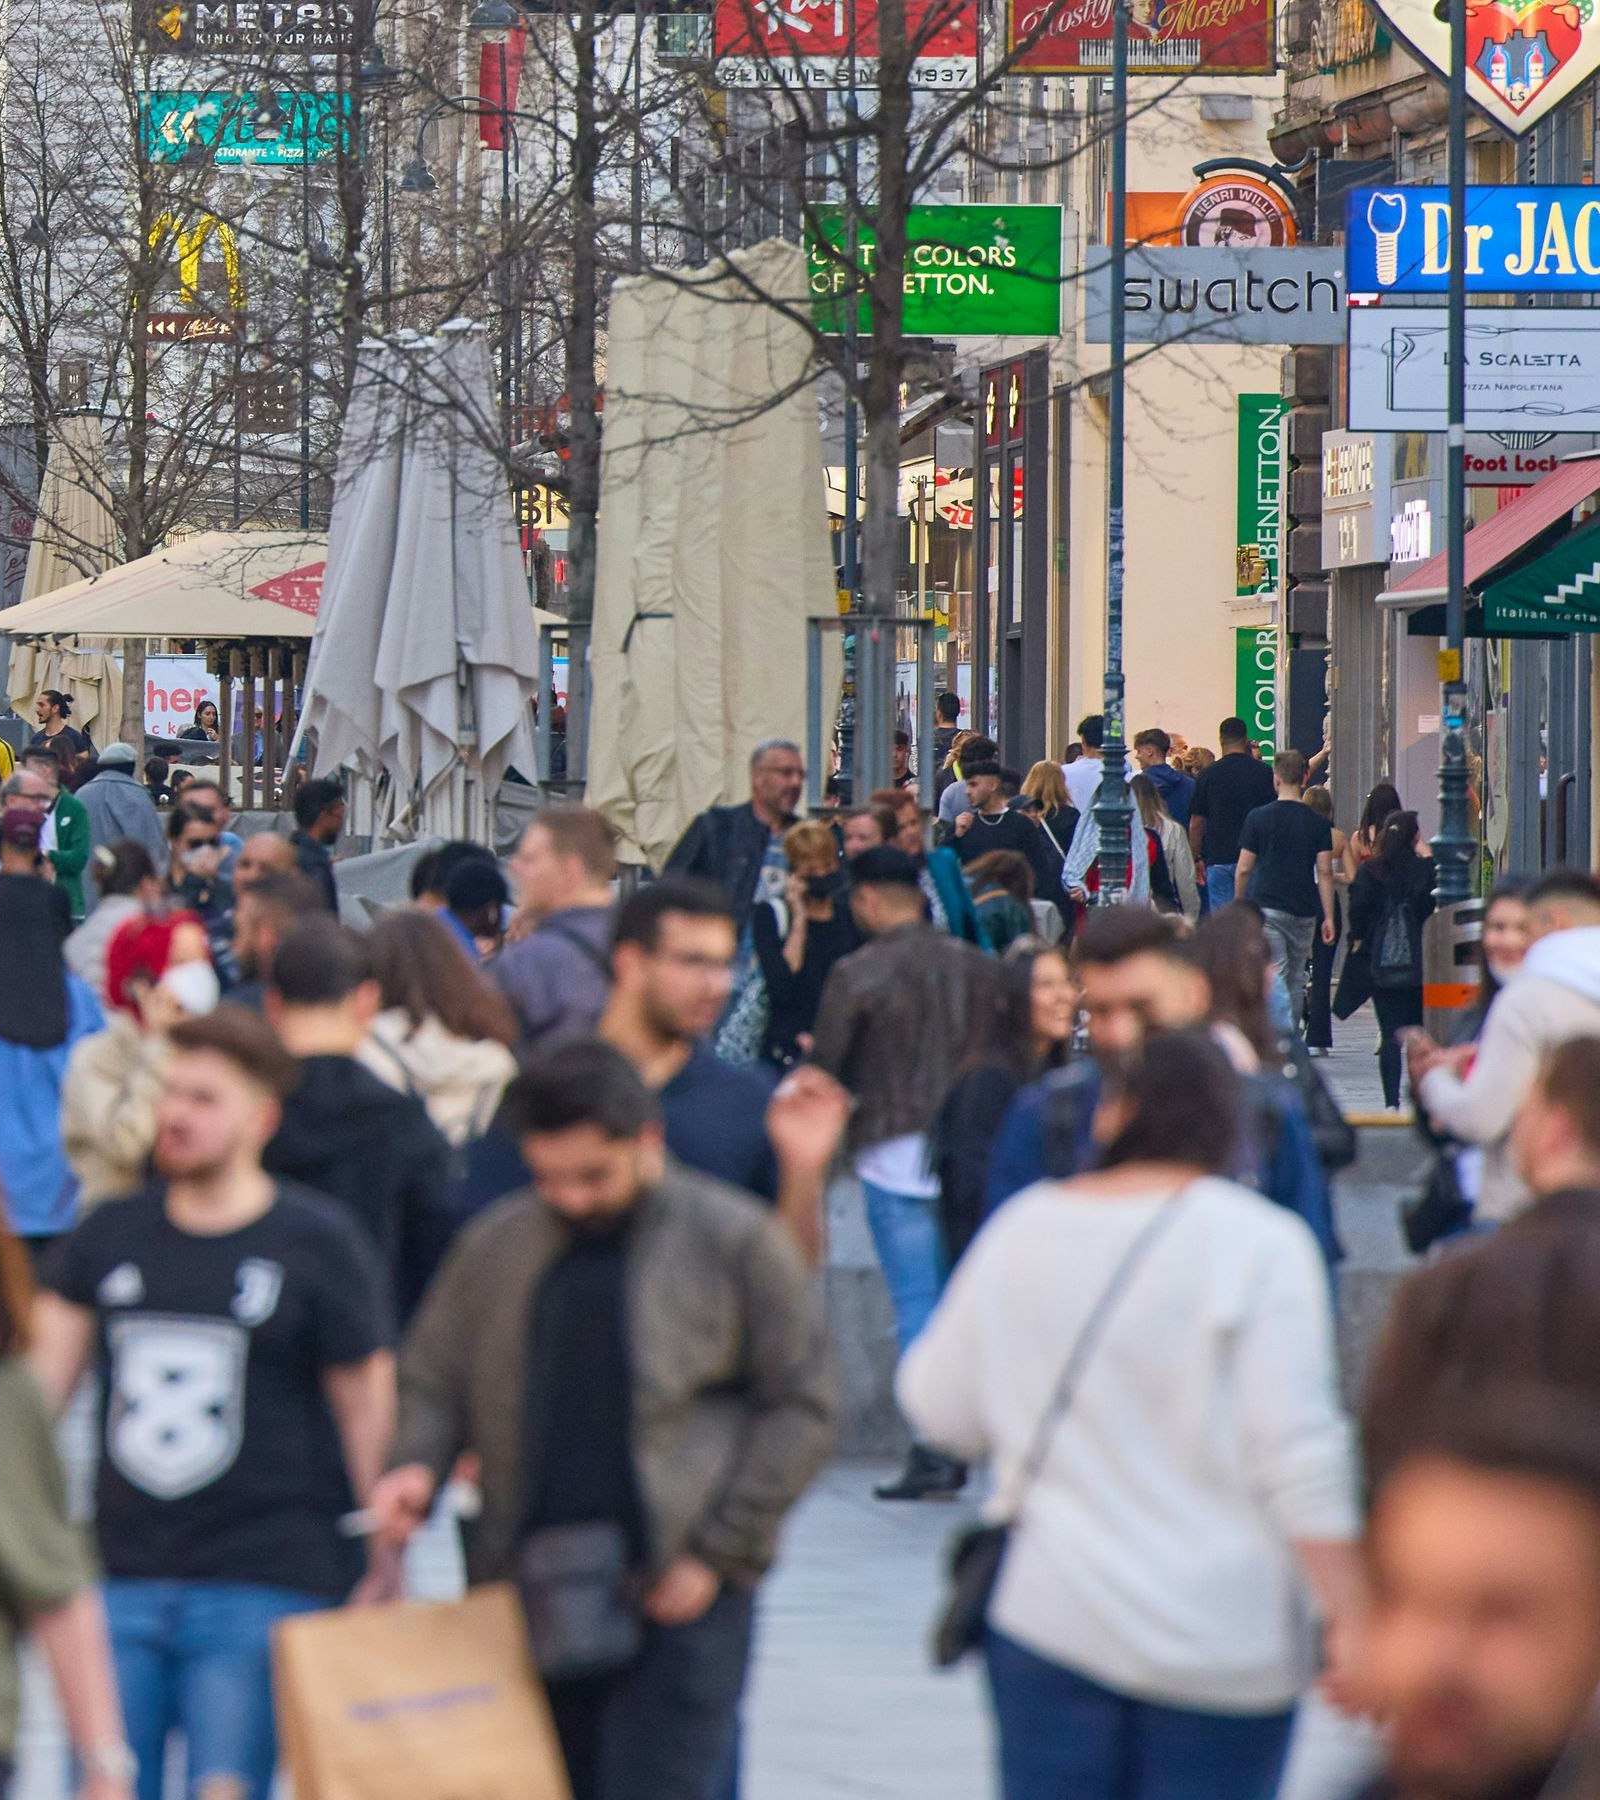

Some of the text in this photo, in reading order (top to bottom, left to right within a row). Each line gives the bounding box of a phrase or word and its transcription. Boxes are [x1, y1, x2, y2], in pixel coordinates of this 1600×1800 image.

[196, 3, 354, 29] METRO
[196, 33, 234, 44] KINO
[242, 33, 305, 44] KUTUR
[915, 69, 969, 82] 1937
[213, 148, 268, 157] STORANTE
[1195, 189, 1234, 218] HENRI
[1420, 202, 1494, 276] Dr
[914, 245, 1016, 268] COLORS
[811, 273, 845, 293] OF
[1123, 270, 1338, 315] swatch
[1256, 404, 1282, 559] BENETTON.
[1496, 606, 1548, 620] italian
[147, 680, 208, 713] her
